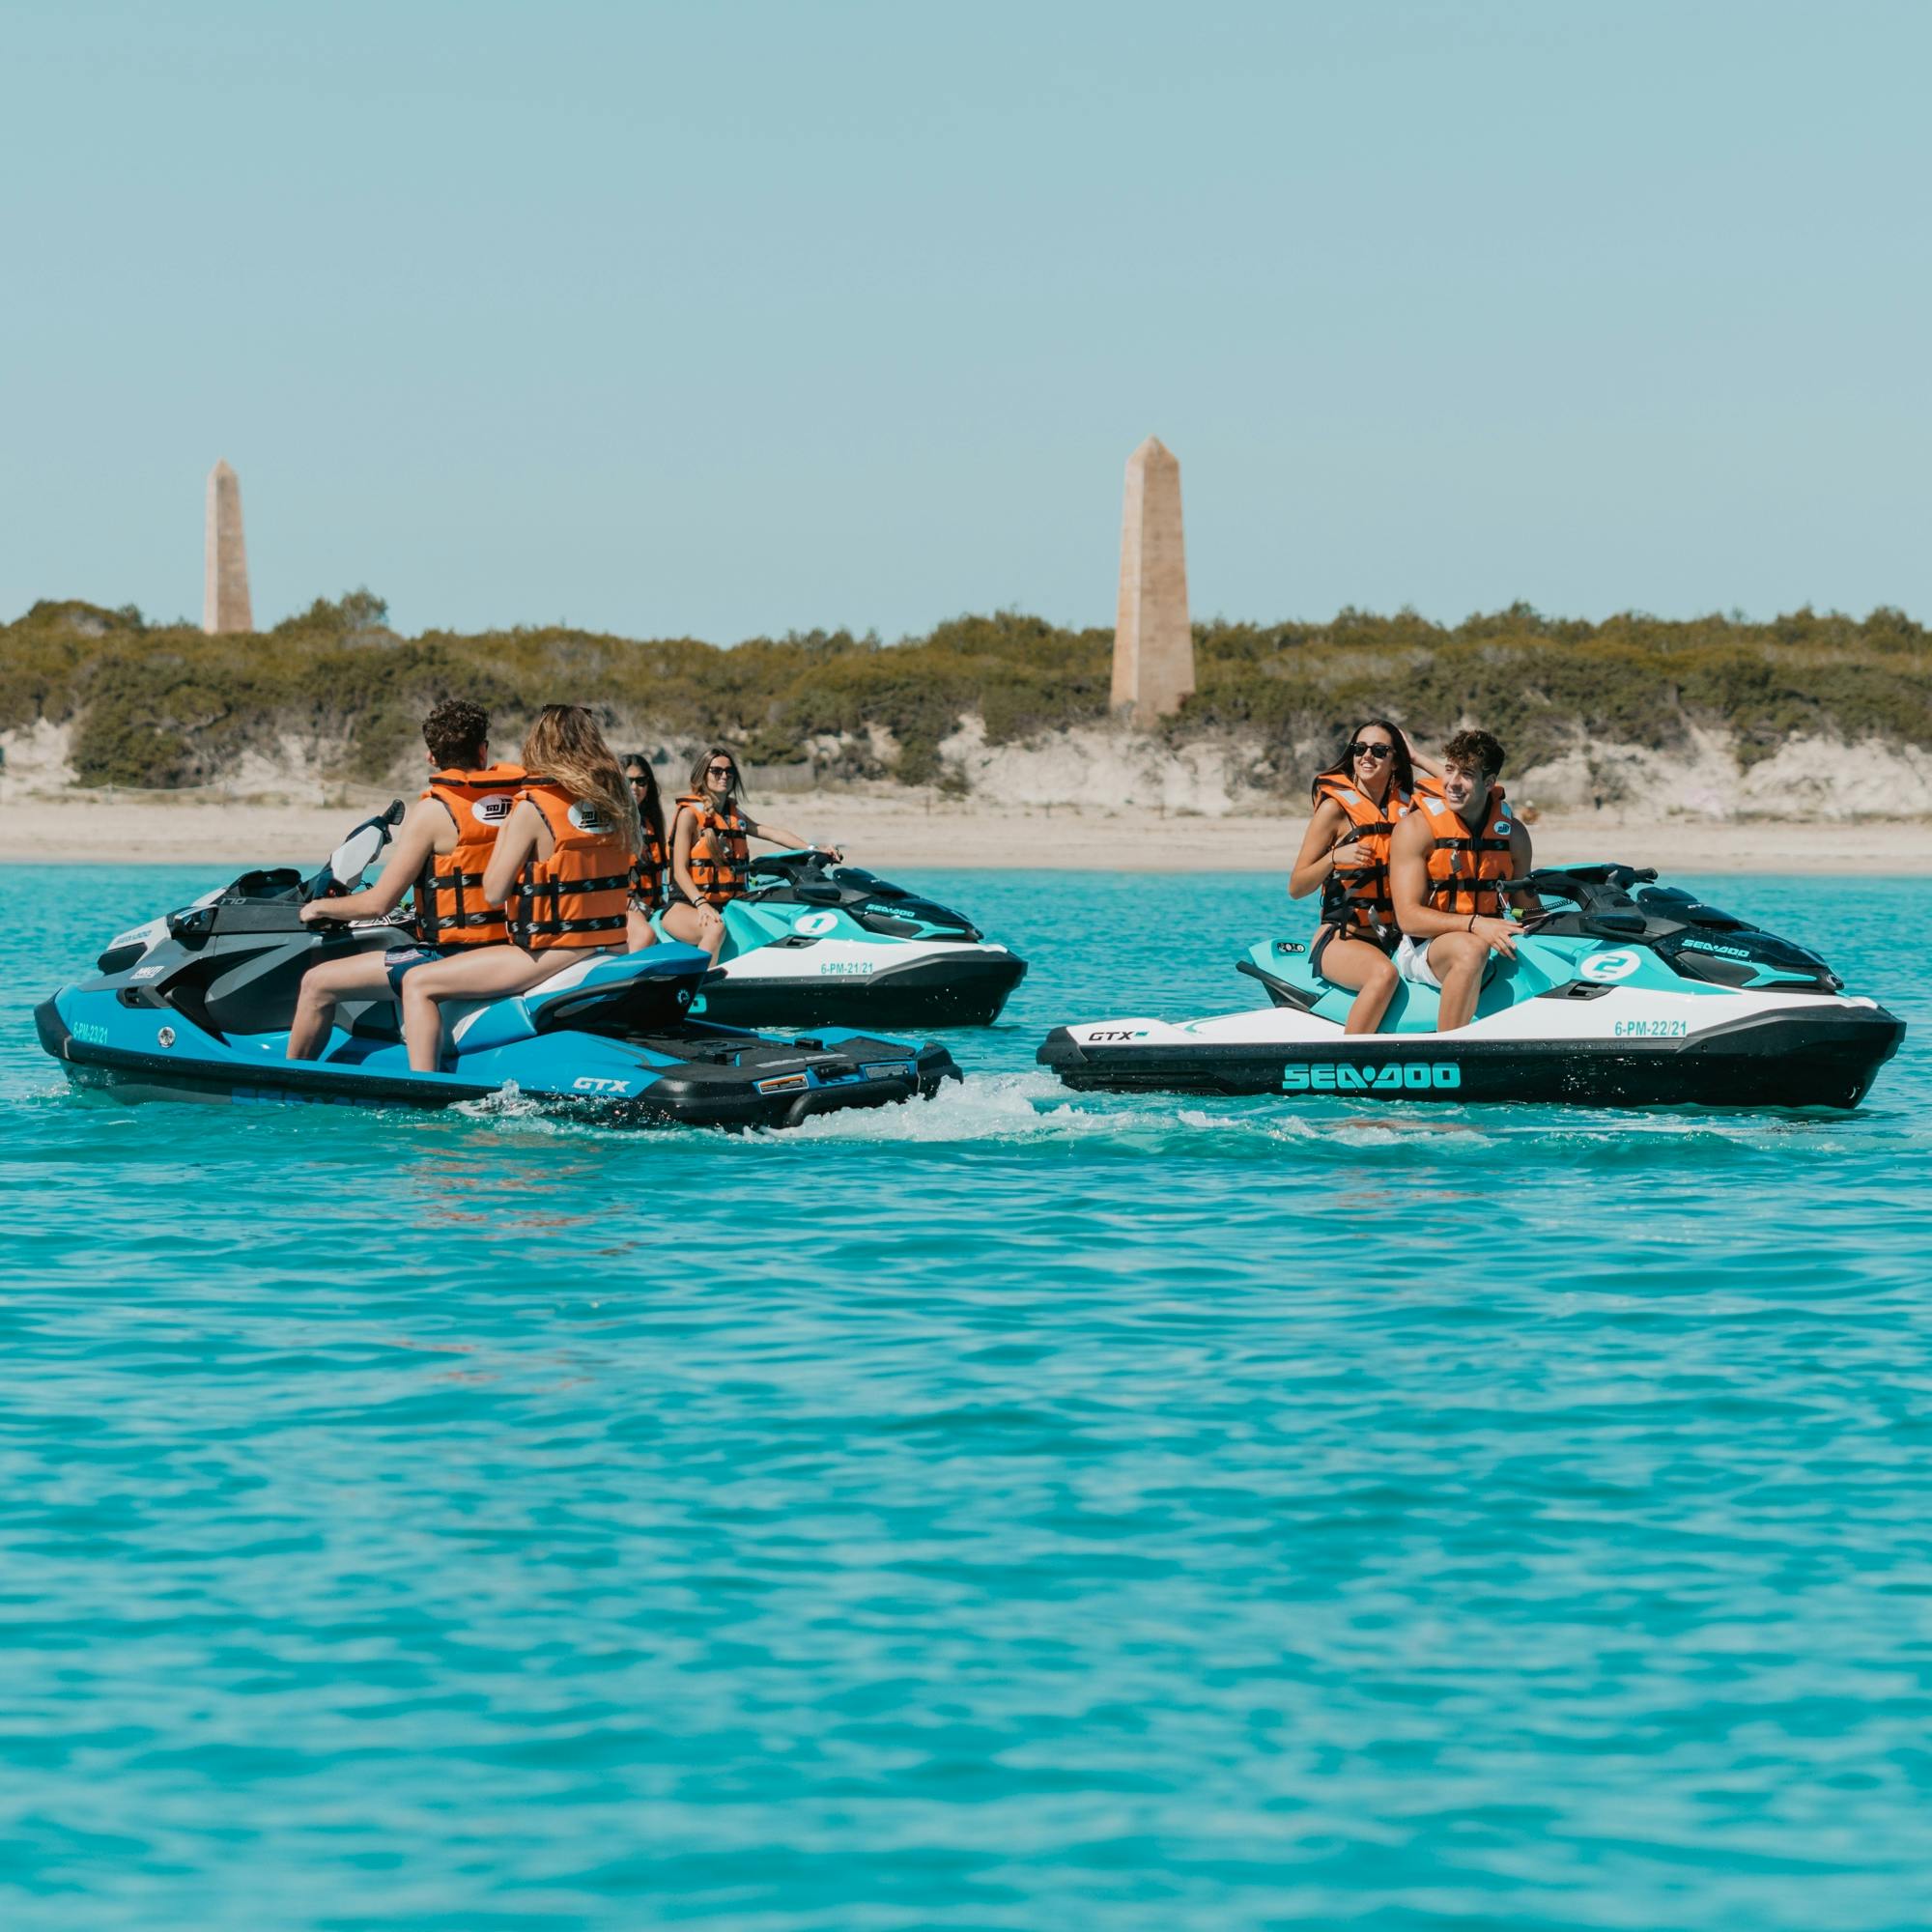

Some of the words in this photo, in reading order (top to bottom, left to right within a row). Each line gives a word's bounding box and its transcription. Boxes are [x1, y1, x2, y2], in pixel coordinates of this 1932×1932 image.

[1593, 955, 1631, 974] 2
[1089, 1031, 1134, 1041] GTX
[1614, 1020, 1688, 1037] 6-PM-22/21
[573, 1077, 631, 1093] GTX
